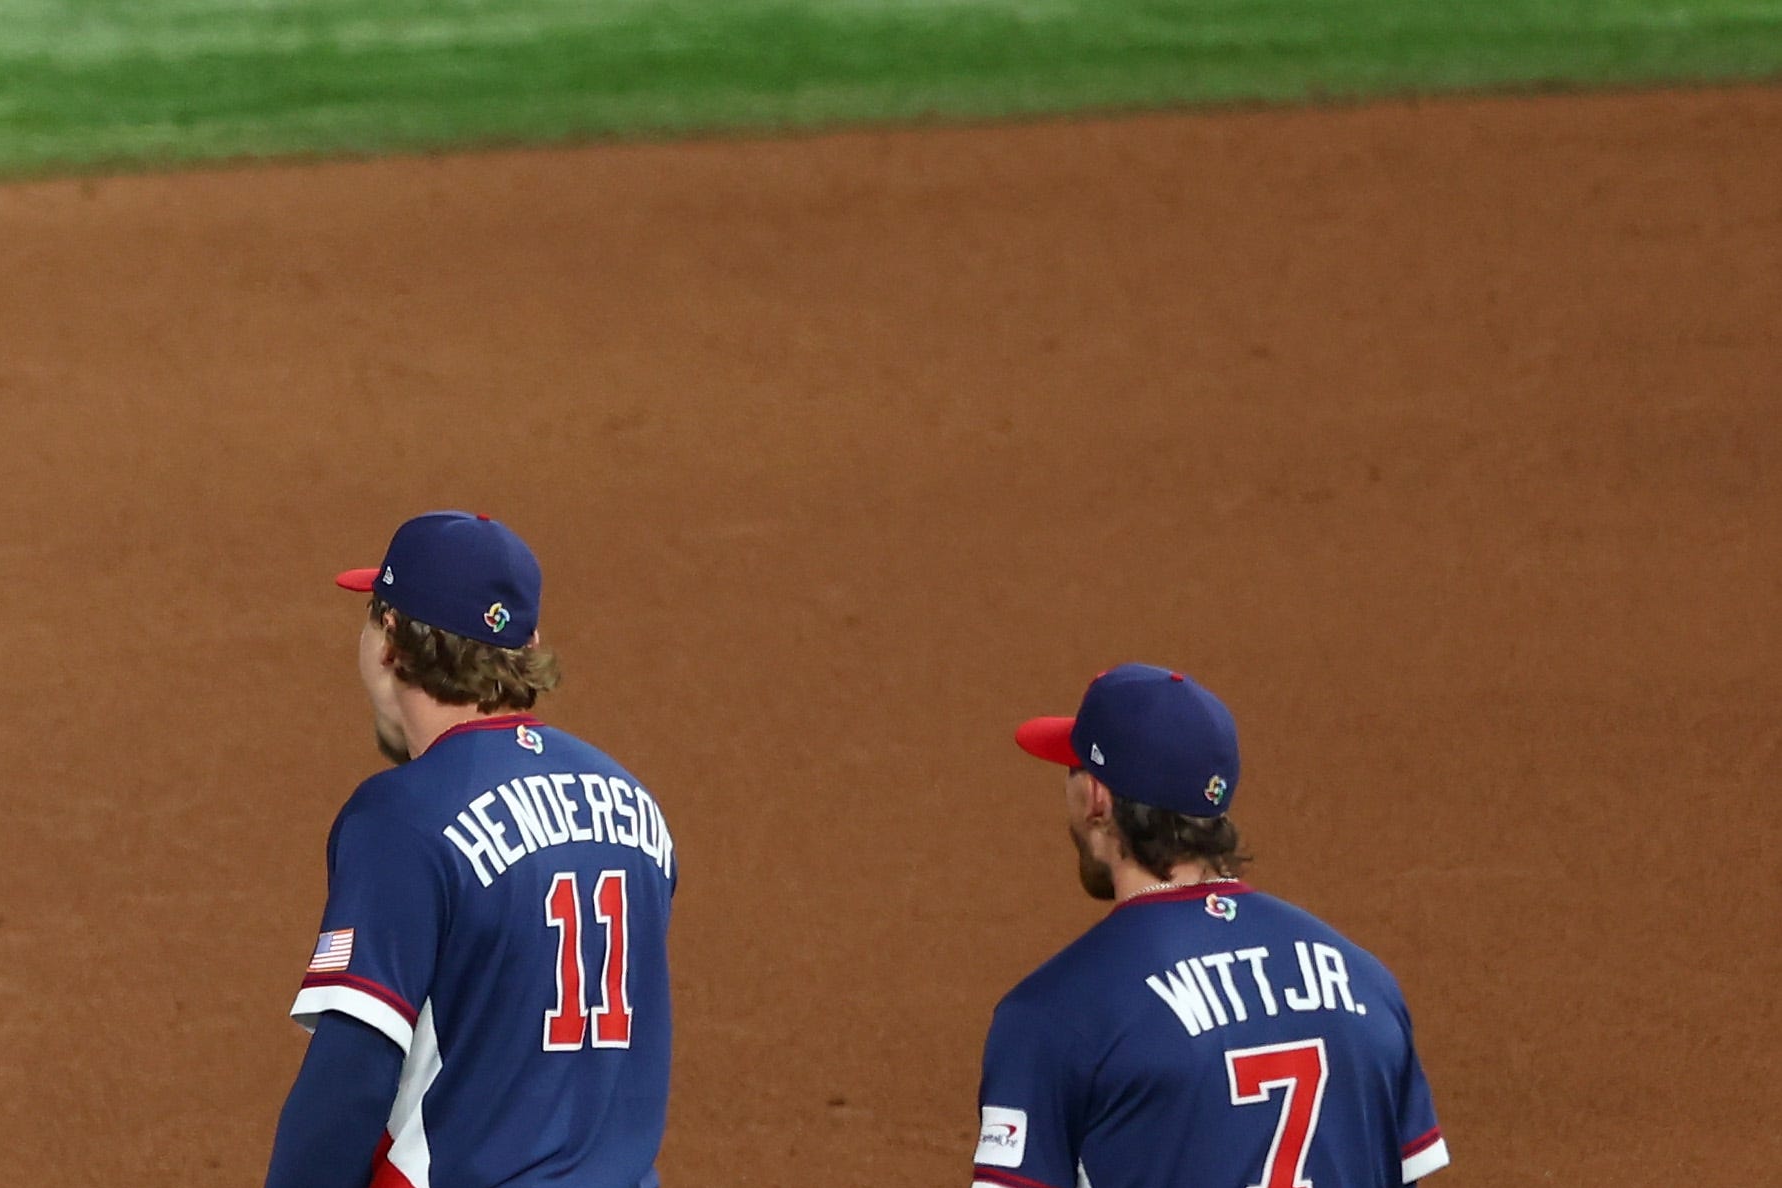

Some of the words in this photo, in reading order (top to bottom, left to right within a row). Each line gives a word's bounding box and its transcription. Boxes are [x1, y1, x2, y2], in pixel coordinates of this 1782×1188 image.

[443, 773, 674, 888] HENDERSON
[543, 869, 633, 1052] 11
[1145, 946, 1278, 1037] WITT
[1284, 941, 1367, 1016] JR.
